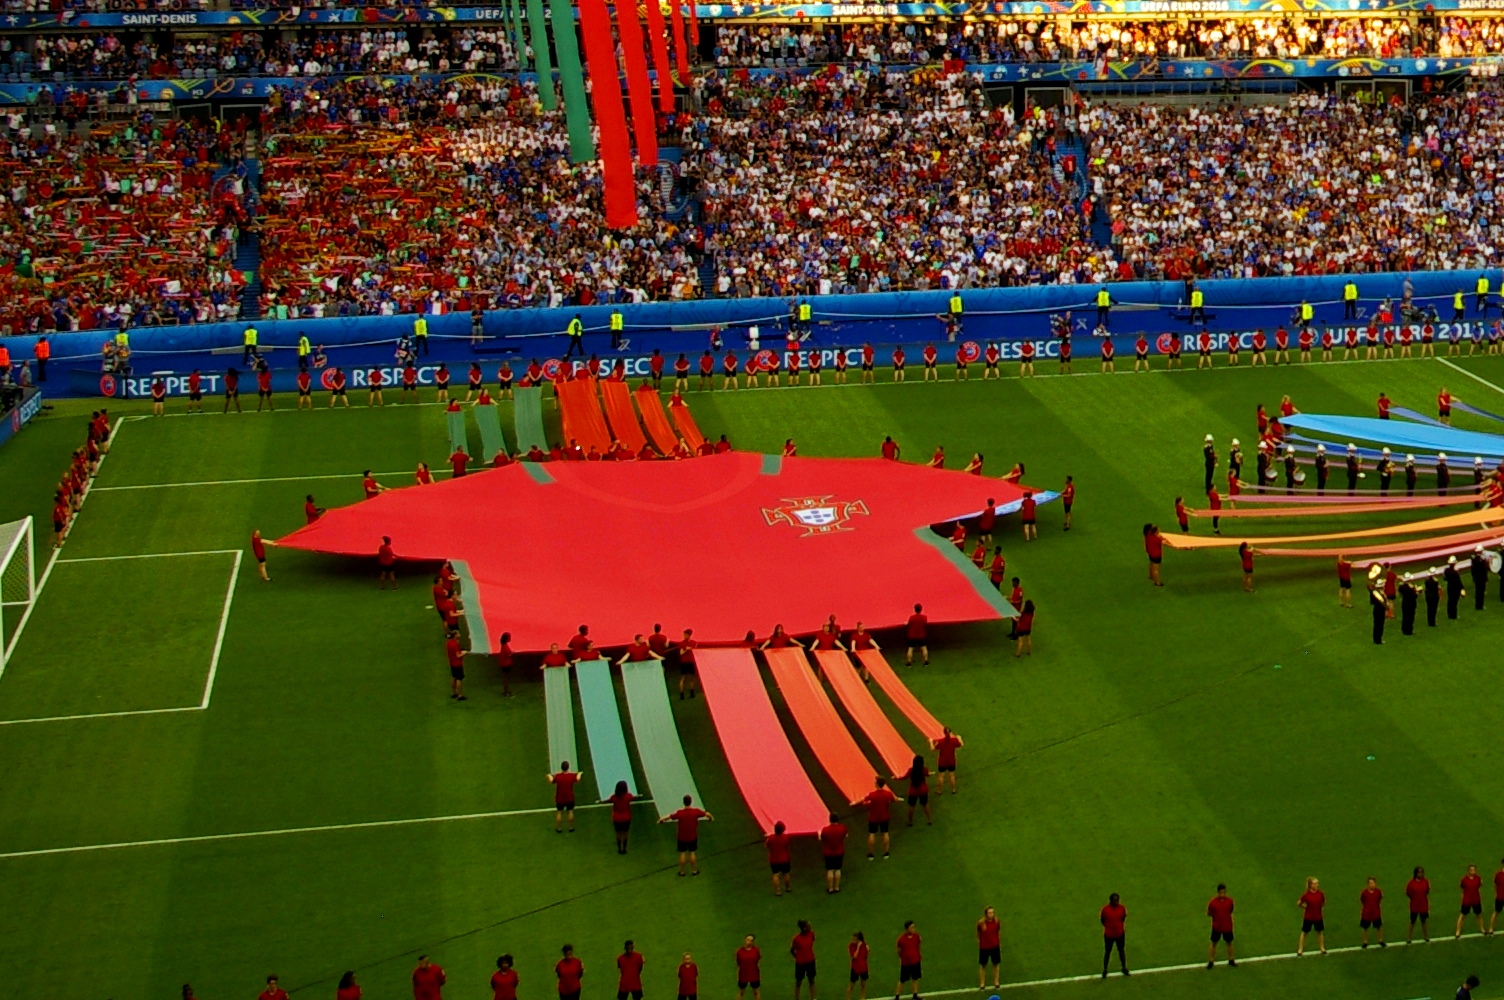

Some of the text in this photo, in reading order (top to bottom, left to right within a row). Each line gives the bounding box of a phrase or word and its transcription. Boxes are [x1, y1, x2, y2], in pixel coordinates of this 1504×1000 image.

[1140, 1, 1228, 11] UEFA EURO 2016
[122, 14, 197, 24] SAINT-DENIS
